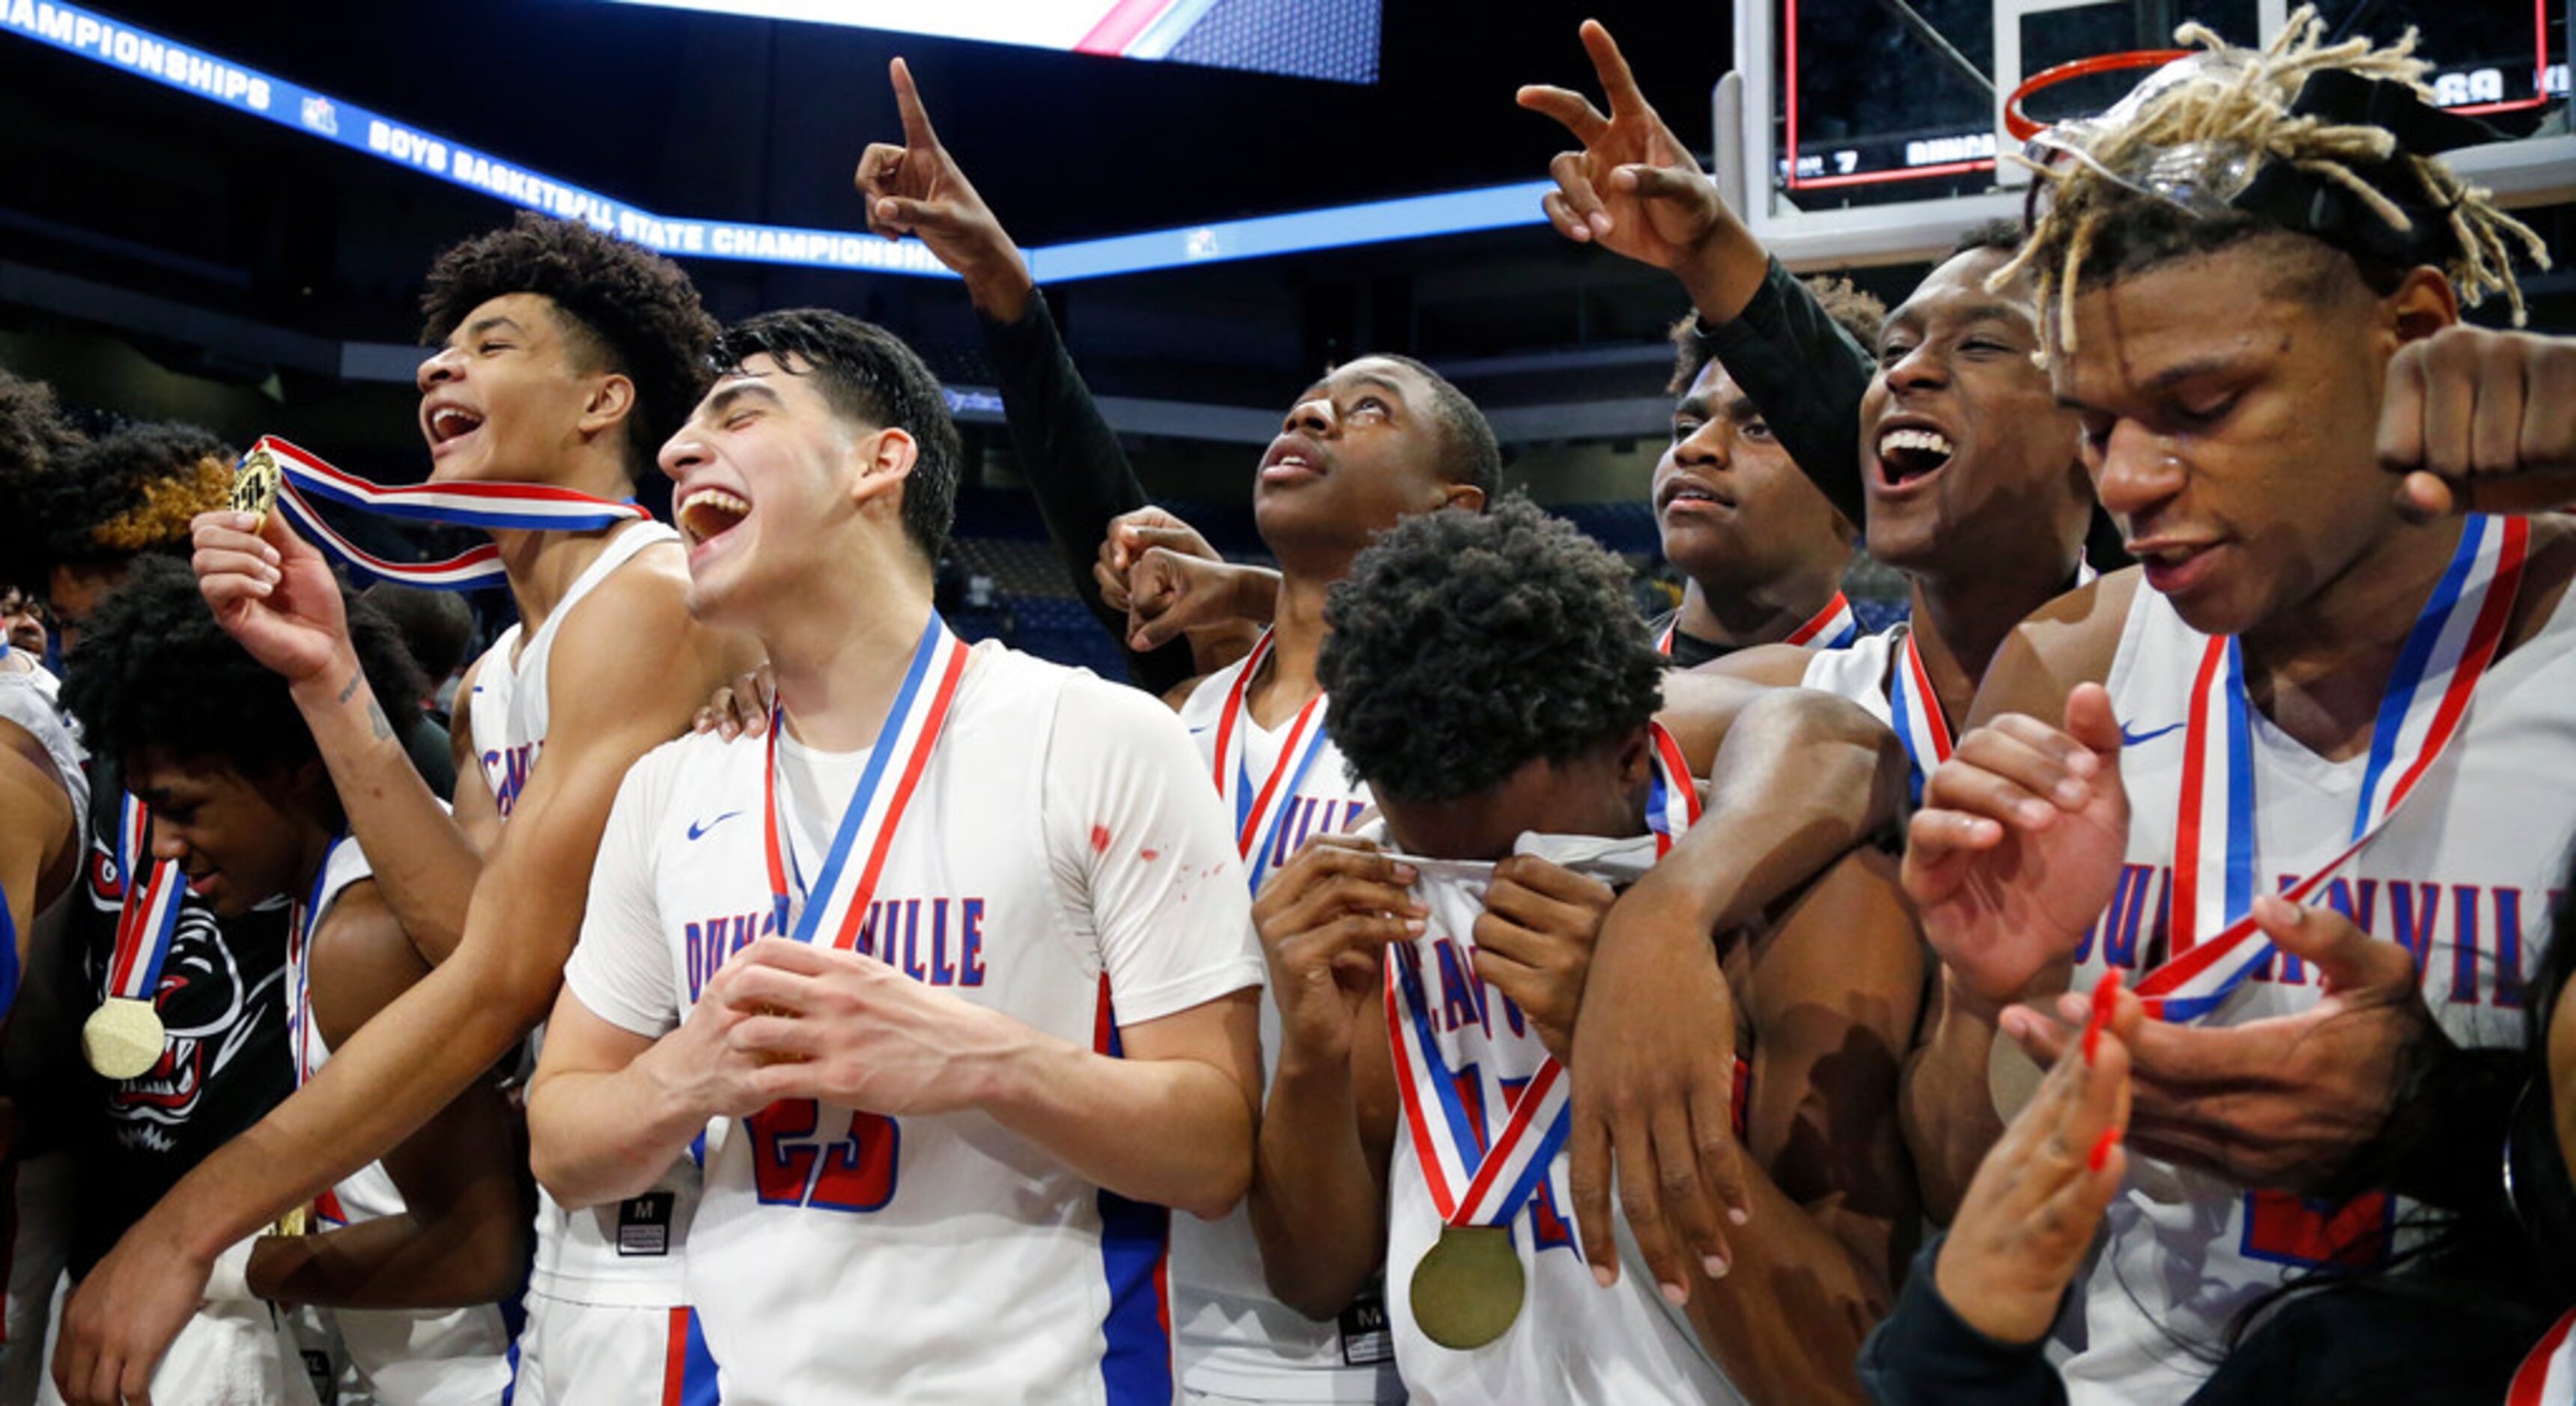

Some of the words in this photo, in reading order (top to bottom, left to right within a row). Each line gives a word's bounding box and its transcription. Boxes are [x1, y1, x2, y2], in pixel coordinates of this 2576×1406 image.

[368, 120, 447, 171] BOYS
[454, 150, 614, 233] BASKETBALL
[620, 210, 702, 252] STATE
[634, 1201, 653, 1219] M
